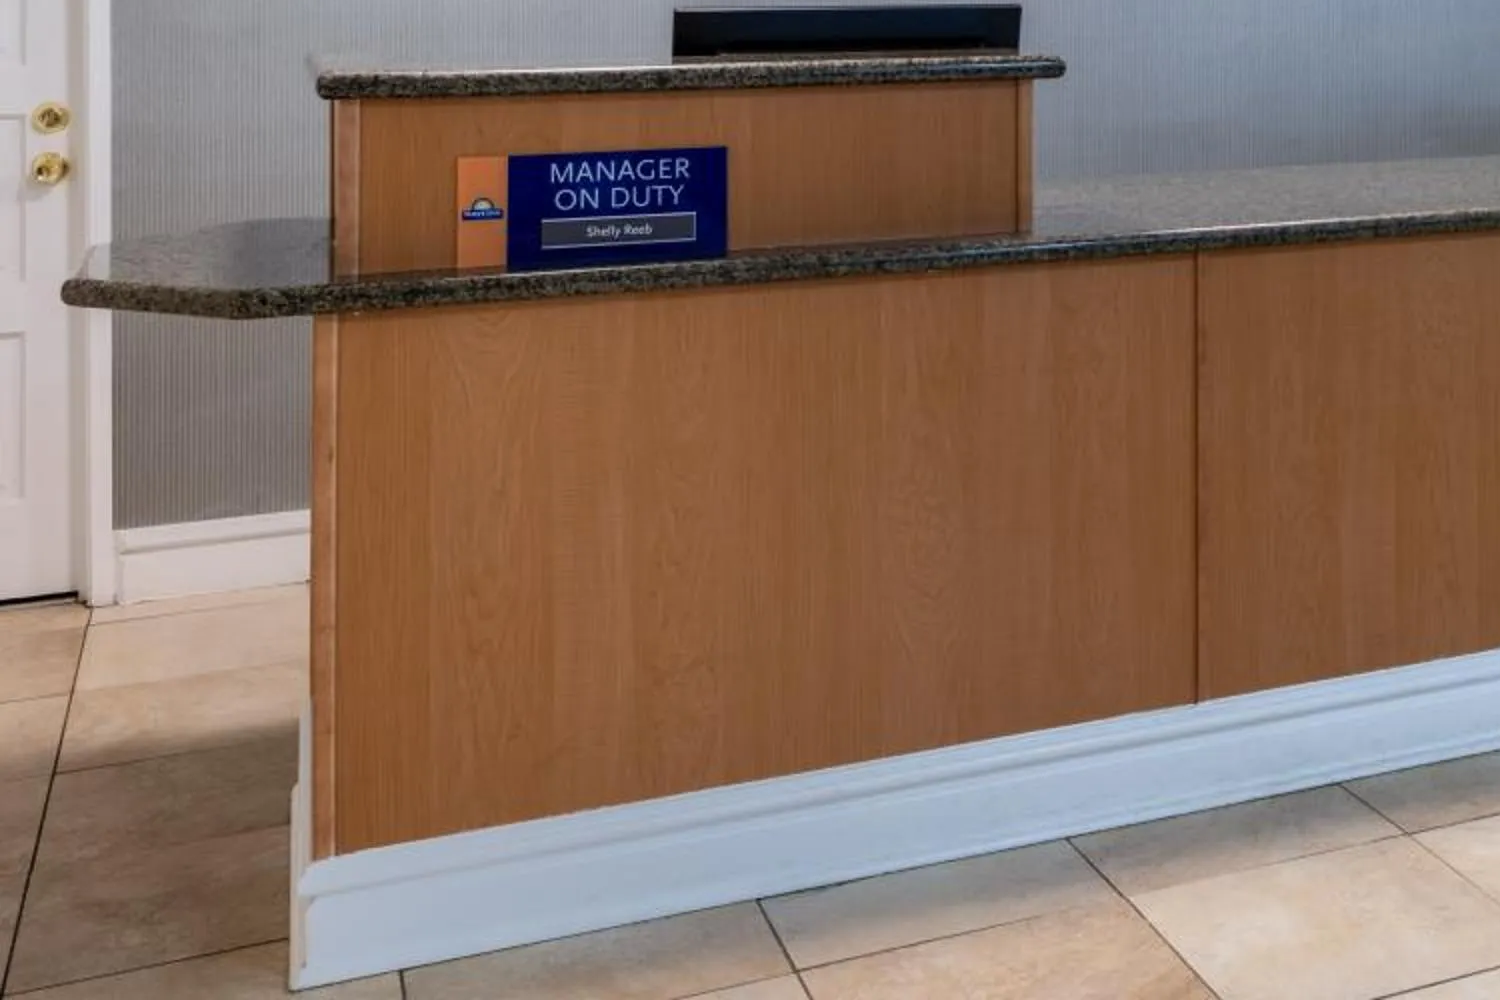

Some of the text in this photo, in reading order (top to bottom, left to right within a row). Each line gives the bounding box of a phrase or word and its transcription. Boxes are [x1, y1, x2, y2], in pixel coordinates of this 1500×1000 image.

[550, 157, 691, 184] MANAGER
[554, 184, 685, 211] ON DUTY
